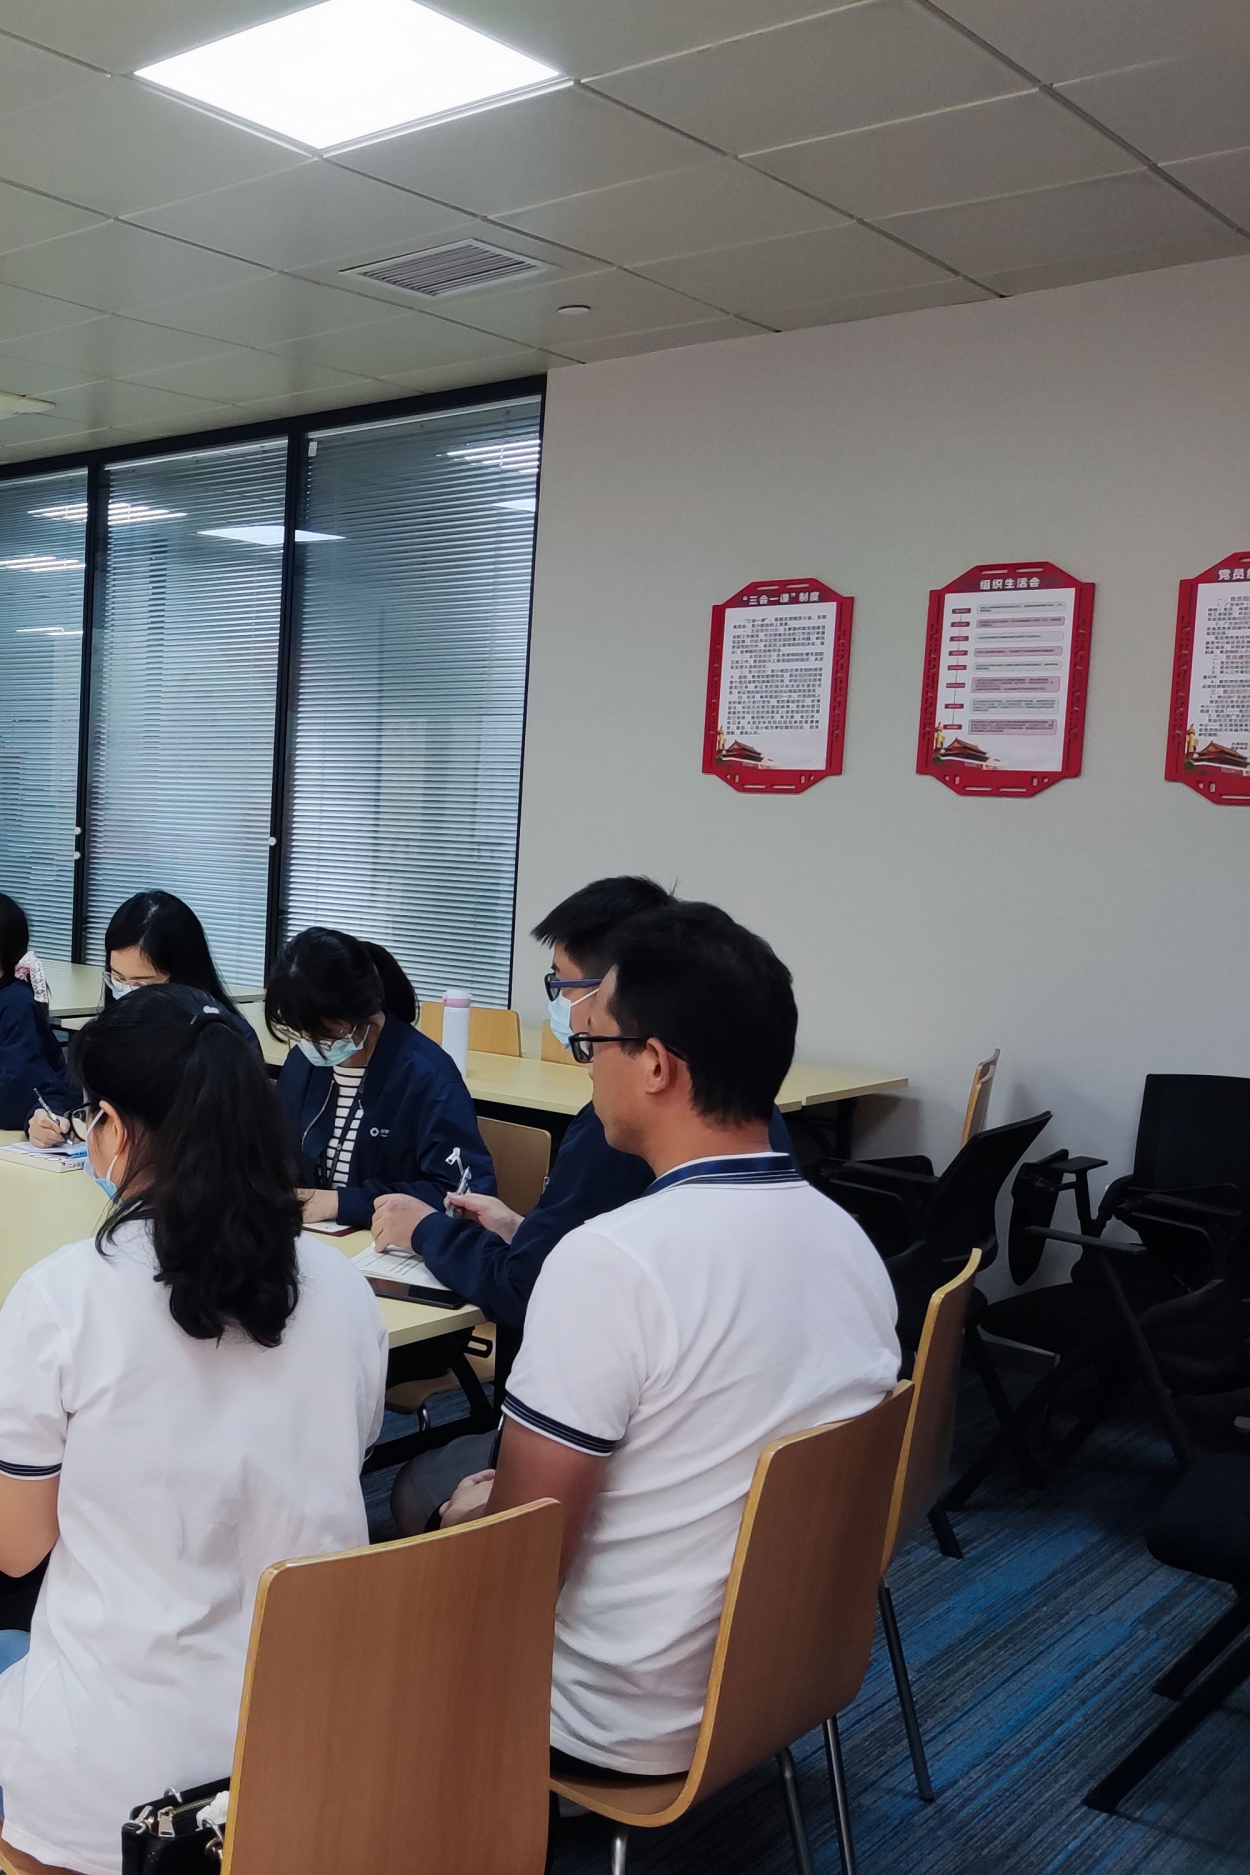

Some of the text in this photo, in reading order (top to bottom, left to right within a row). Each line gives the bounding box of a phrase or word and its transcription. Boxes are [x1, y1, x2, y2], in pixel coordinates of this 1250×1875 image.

[979, 577, 1040, 590] 组织生活会
